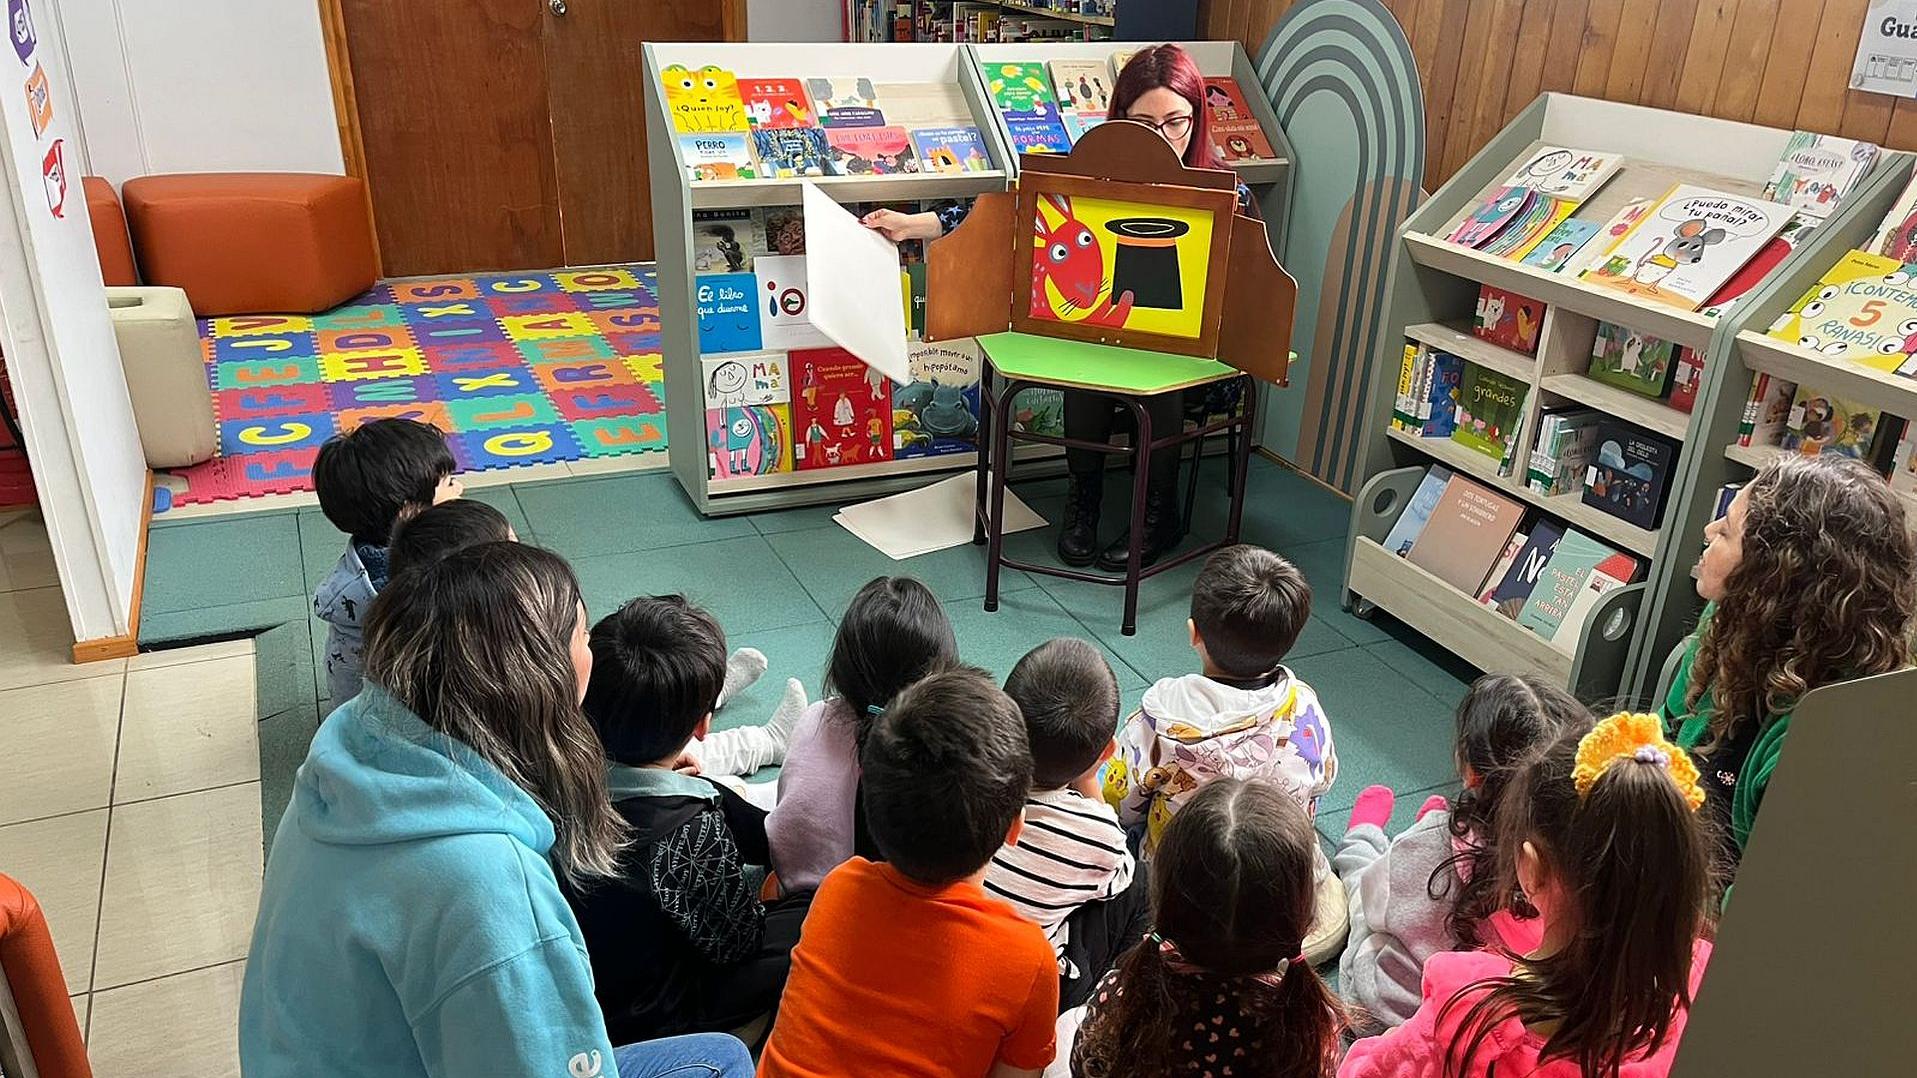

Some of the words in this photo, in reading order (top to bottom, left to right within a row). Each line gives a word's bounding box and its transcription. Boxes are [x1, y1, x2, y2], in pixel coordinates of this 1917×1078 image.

[695, 140, 726, 150] PERRO
[1683, 199, 1728, 210] ¿Puedo
[1731, 205, 1763, 223] mirar
[1688, 208, 1700, 216] tu
[1704, 212, 1747, 228] pañal?
[491, 279, 542, 293] C
[698, 285, 714, 303] El
[719, 287, 744, 301] libro
[698, 304, 715, 320] que
[717, 303, 748, 314] duerme
[1849, 300, 1887, 327] 5
[1816, 319, 1882, 350] RANAS!
[452, 372, 520, 392] X
[552, 364, 613, 383] R
[1474, 385, 1515, 407] grandes
[238, 422, 312, 446] C
[483, 430, 553, 457] Q
[593, 423, 663, 445] E
